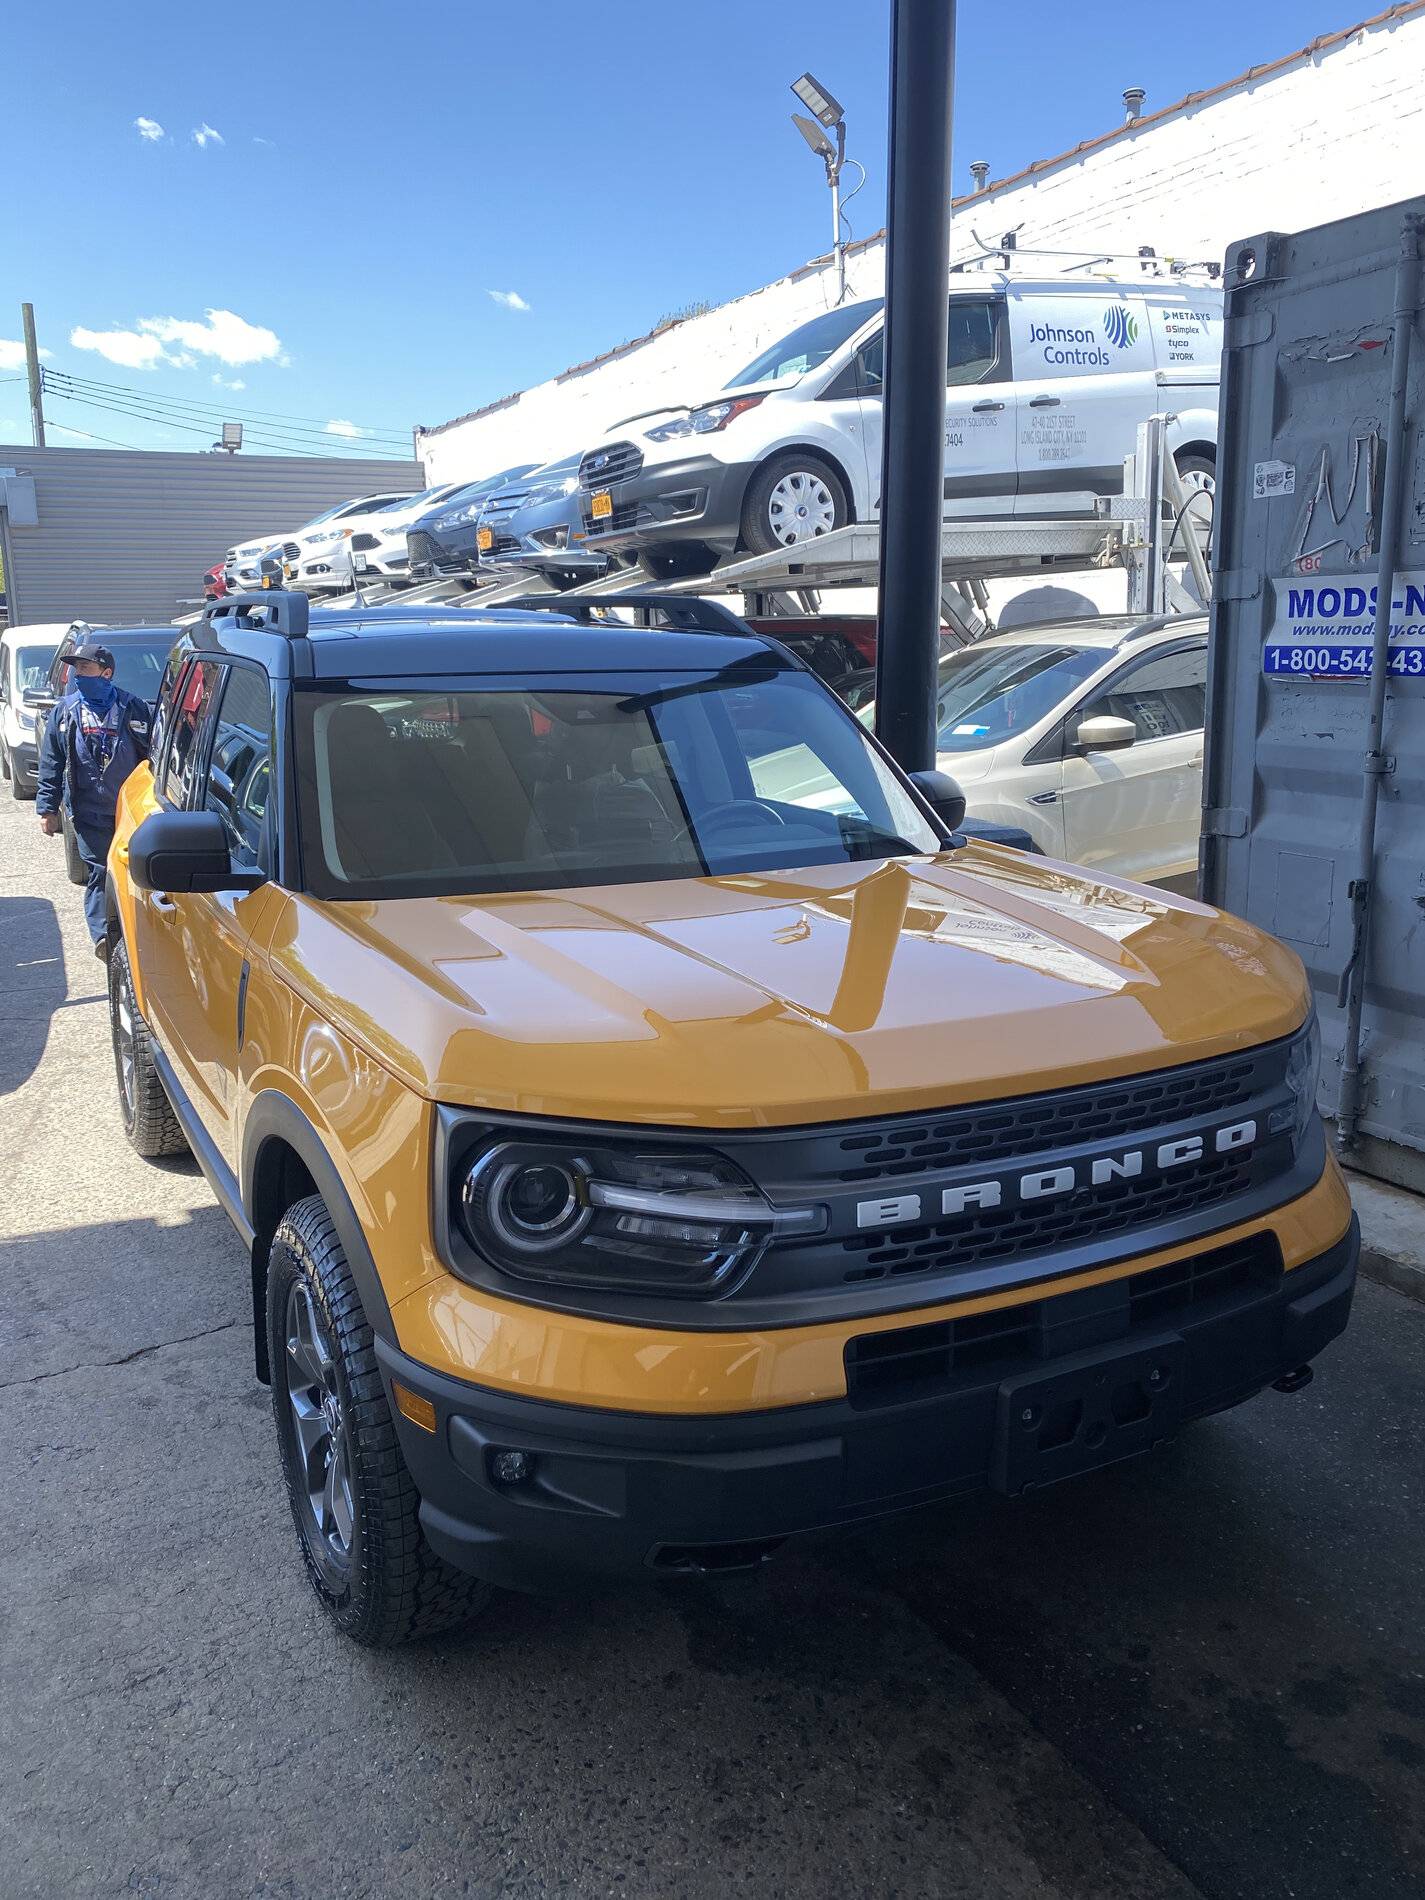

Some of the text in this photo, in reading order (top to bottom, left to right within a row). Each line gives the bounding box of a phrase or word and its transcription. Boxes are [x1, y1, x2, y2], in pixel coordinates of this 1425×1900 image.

[1172, 312, 1211, 321] METASYS
[1030, 323, 1095, 343] Johnson
[1172, 325, 1199, 335] Simplex
[1168, 339, 1189, 349] tyco
[1044, 347, 1110, 366] Controls
[1175, 352, 1194, 361] YORK
[945, 417, 966, 428] ECURITY
[1059, 415, 1076, 429] STREET
[1021, 430, 1034, 444] LONG
[1035, 430, 1052, 444] ISLAND
[1293, 622, 1425, 639] www.mody.co
[1271, 648, 1425, 673] 1-800-54-43
[857, 1120, 1257, 1228] BRONCO
